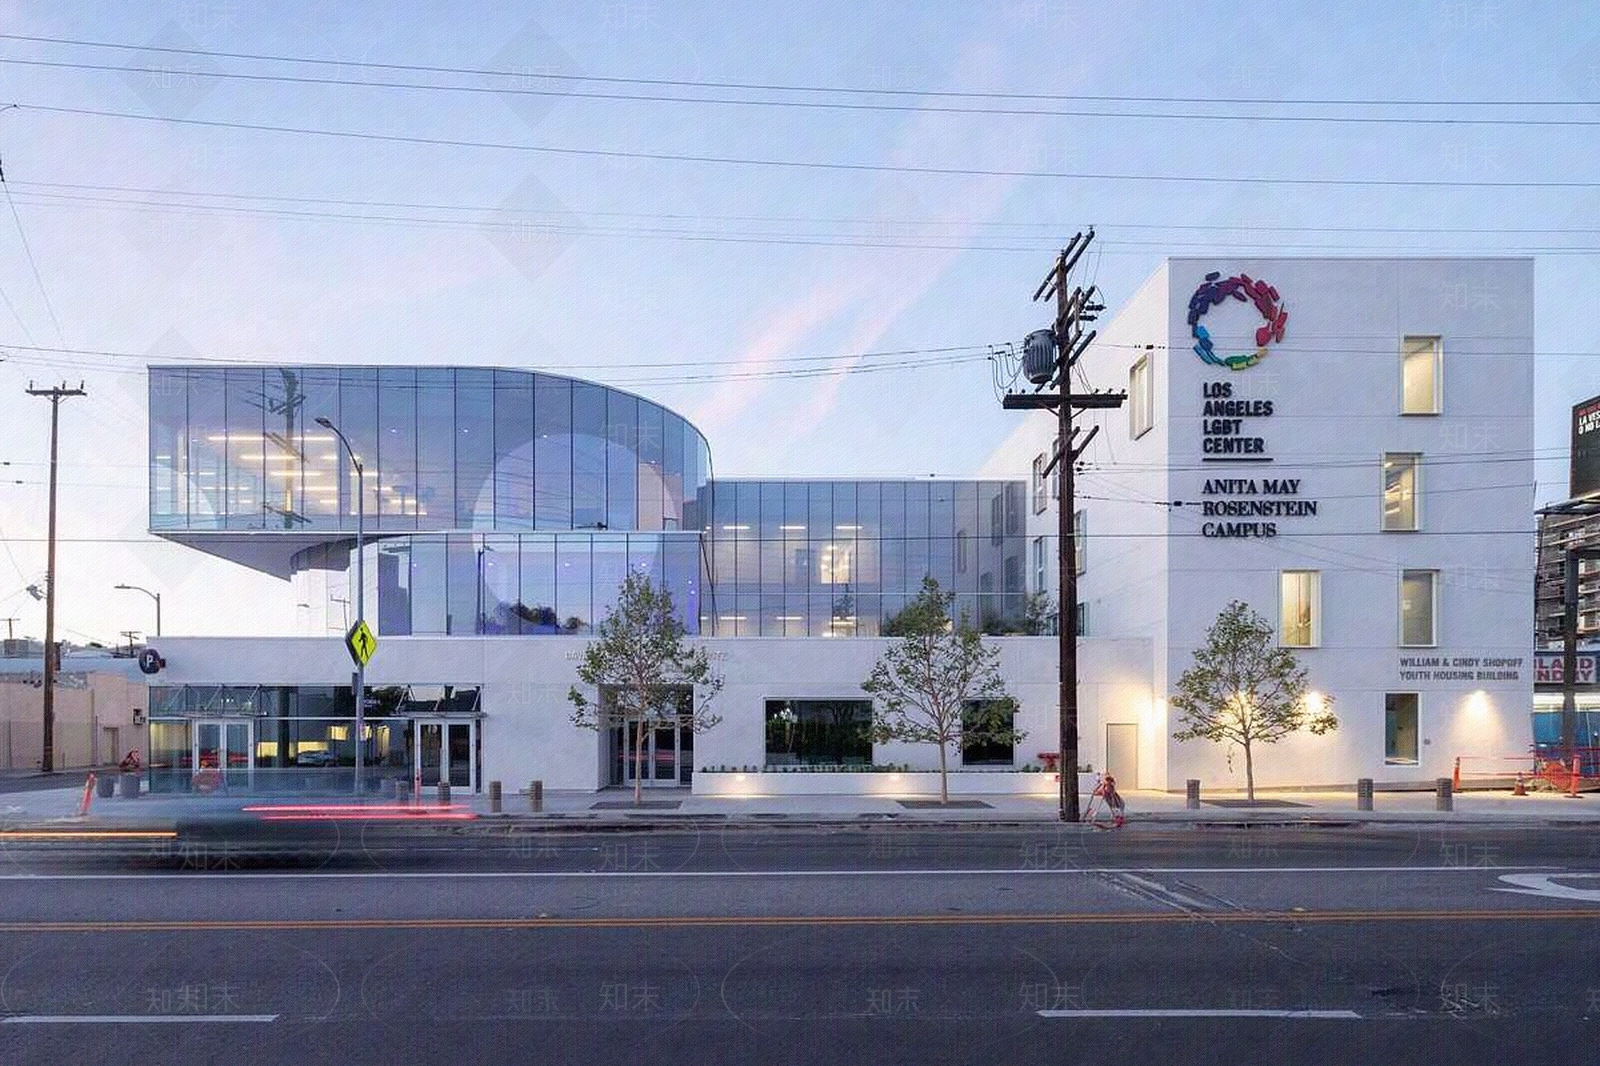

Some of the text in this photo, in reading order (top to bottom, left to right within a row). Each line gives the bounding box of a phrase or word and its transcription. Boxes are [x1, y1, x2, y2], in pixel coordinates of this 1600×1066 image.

[1203, 382, 1232, 398] LOS
[1203, 400, 1273, 417] ANGELES
[1203, 419, 1243, 435] LGBT
[1203, 437, 1265, 453] CENTER
[1202, 479, 1301, 494] ANITA MAY
[1202, 501, 1318, 516] ROSENSTEIN
[1202, 522, 1277, 537] CAMPUS
[146, 654, 154, 668] P
[1400, 658, 1439, 667] WILLIAM
[1442, 658, 1450, 667] &
[1453, 658, 1480, 667] CINDY
[1399, 671, 1519, 680] YOUTH HOUSING BUILDING
